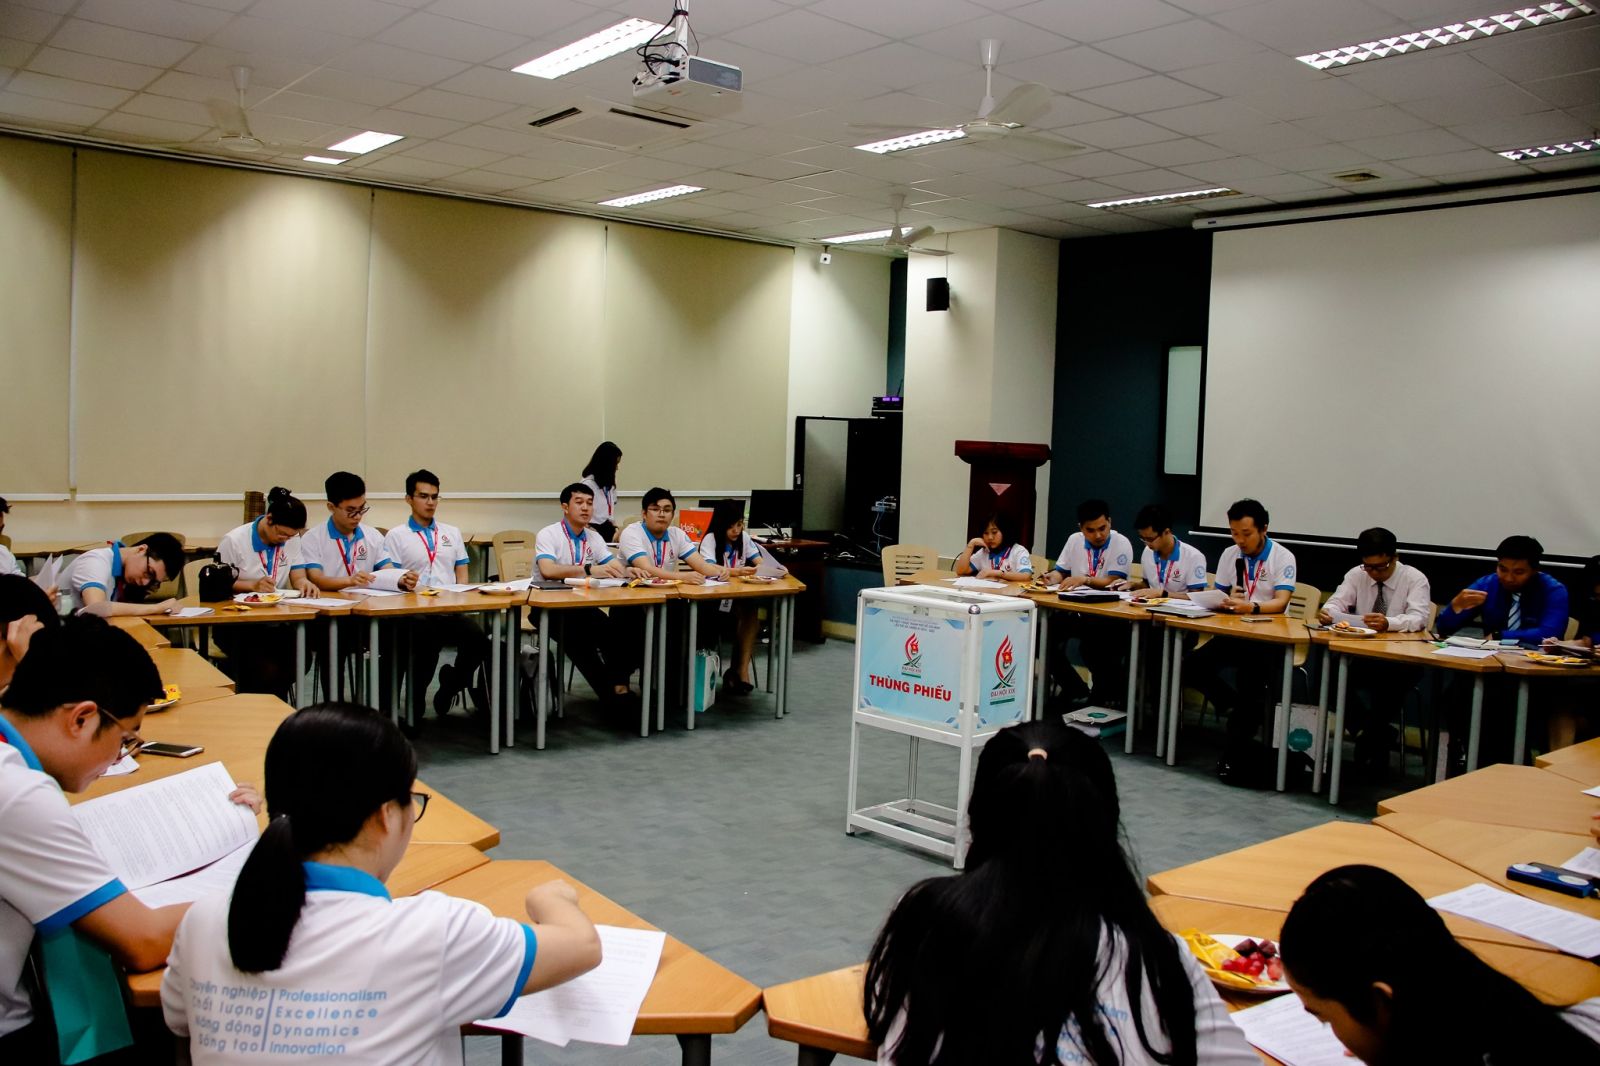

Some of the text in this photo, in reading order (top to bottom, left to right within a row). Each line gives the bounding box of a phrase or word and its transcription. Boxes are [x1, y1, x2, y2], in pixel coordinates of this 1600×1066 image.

[869, 674, 952, 702] THÙNG PHIẾU
[222, 986, 268, 1001] nghiệp
[280, 989, 387, 1002] Professionalism
[275, 1006, 378, 1020] Excellence
[225, 1020, 261, 1037] động
[272, 1024, 359, 1038] Dynamics
[269, 1042, 346, 1055] Innovation
